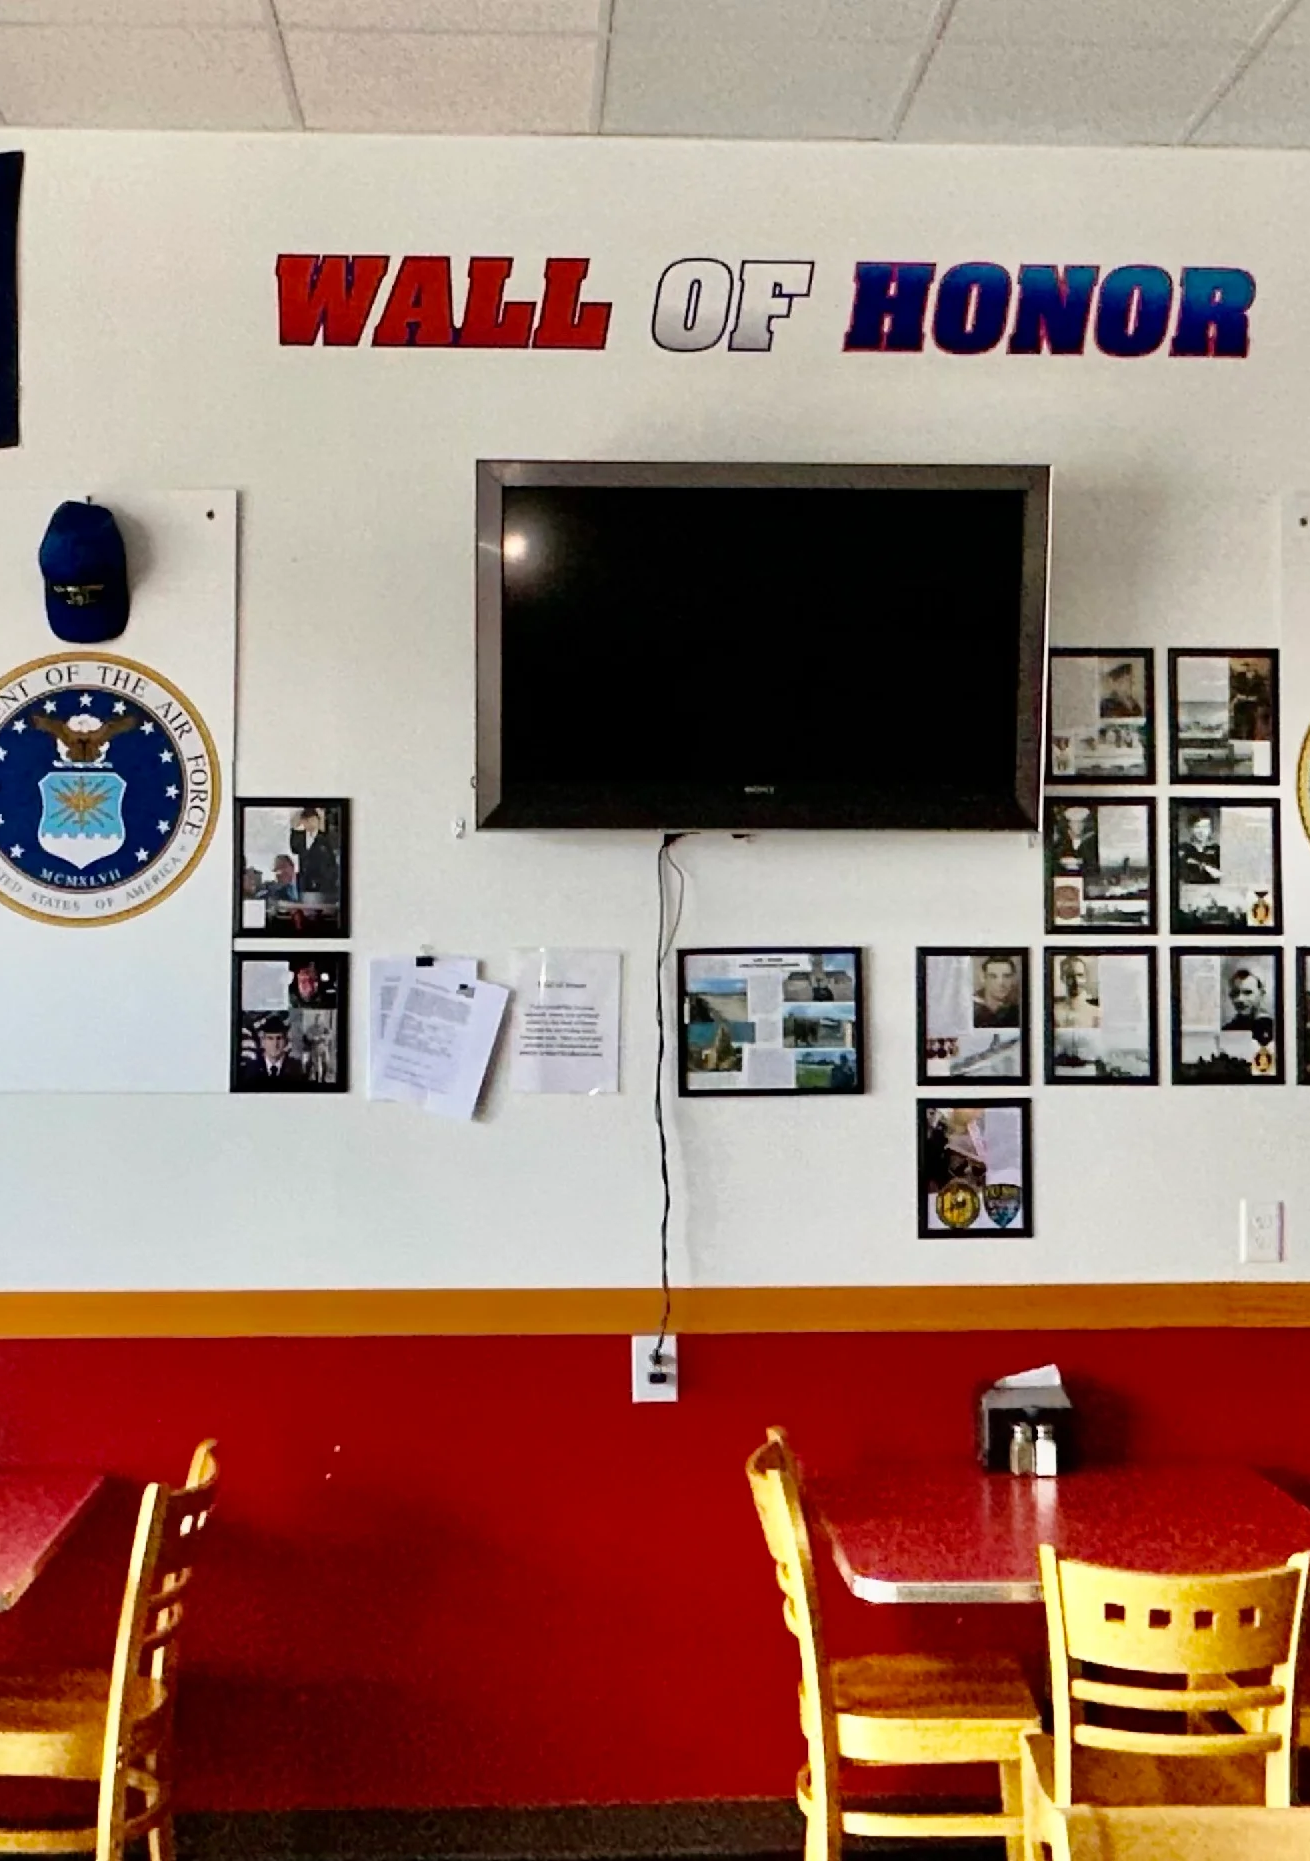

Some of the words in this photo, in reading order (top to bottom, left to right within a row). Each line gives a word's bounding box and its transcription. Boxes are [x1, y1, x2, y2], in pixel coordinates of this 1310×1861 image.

[275, 254, 612, 350] WALL
[652, 258, 814, 353] OF
[842, 261, 1258, 358] HONOR
[45, 665, 80, 686] OF
[97, 665, 149, 699] THE
[154, 699, 193, 741] AIR
[182, 753, 209, 838] FORCE
[31, 891, 81, 912] STATES
[95, 896, 116, 910] OF
[125, 855, 183, 902] AMERICA
[40, 868, 122, 887] MCMXLVII
